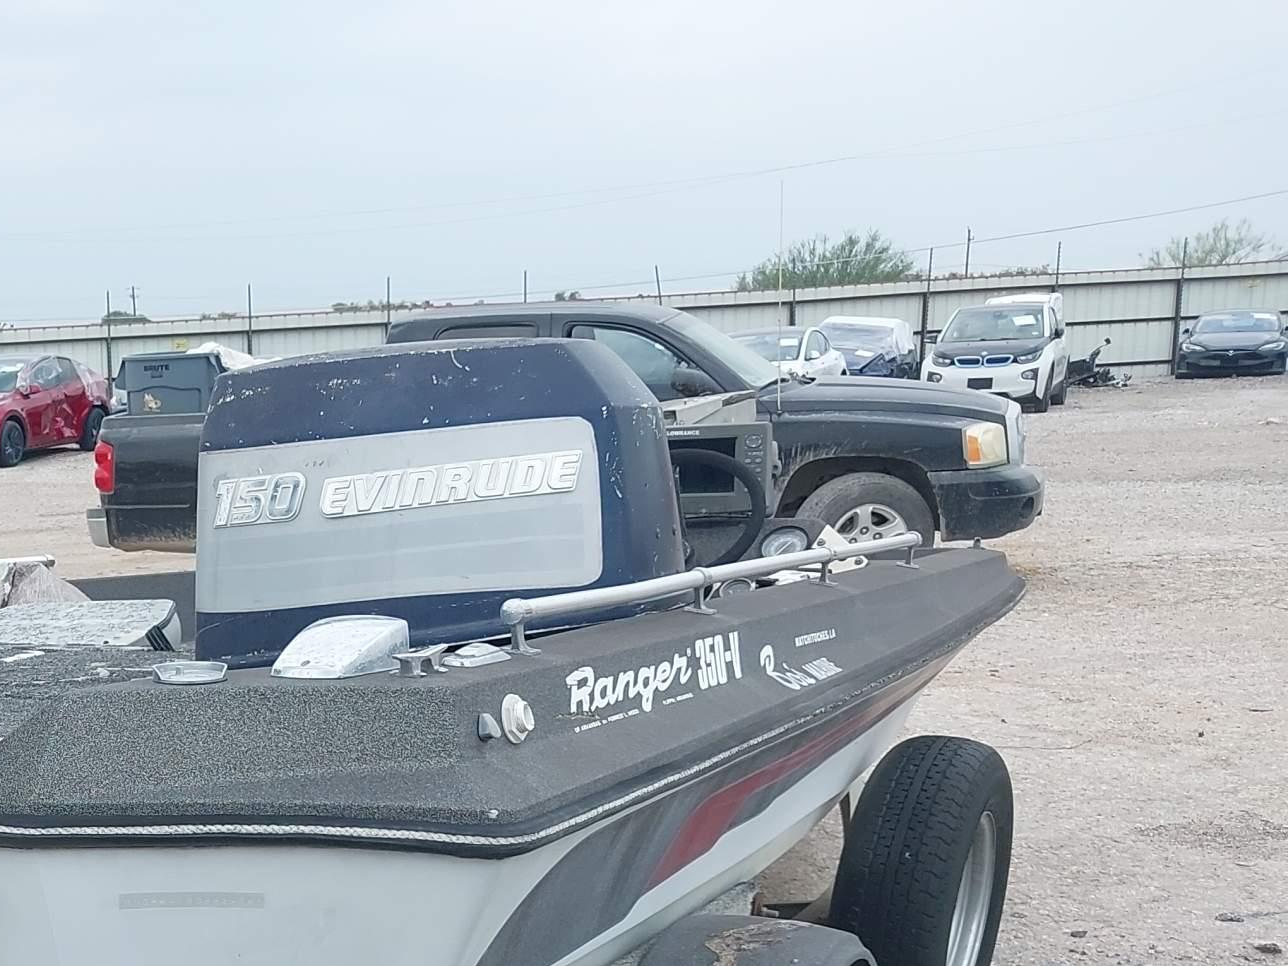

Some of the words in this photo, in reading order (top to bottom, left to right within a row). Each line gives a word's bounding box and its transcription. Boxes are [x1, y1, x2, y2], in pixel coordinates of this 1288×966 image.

[214, 472, 306, 528] 150
[320, 450, 583, 518] EVINRUDE
[566, 653, 693, 712] Ranger
[694, 631, 743, 690] 350-V
